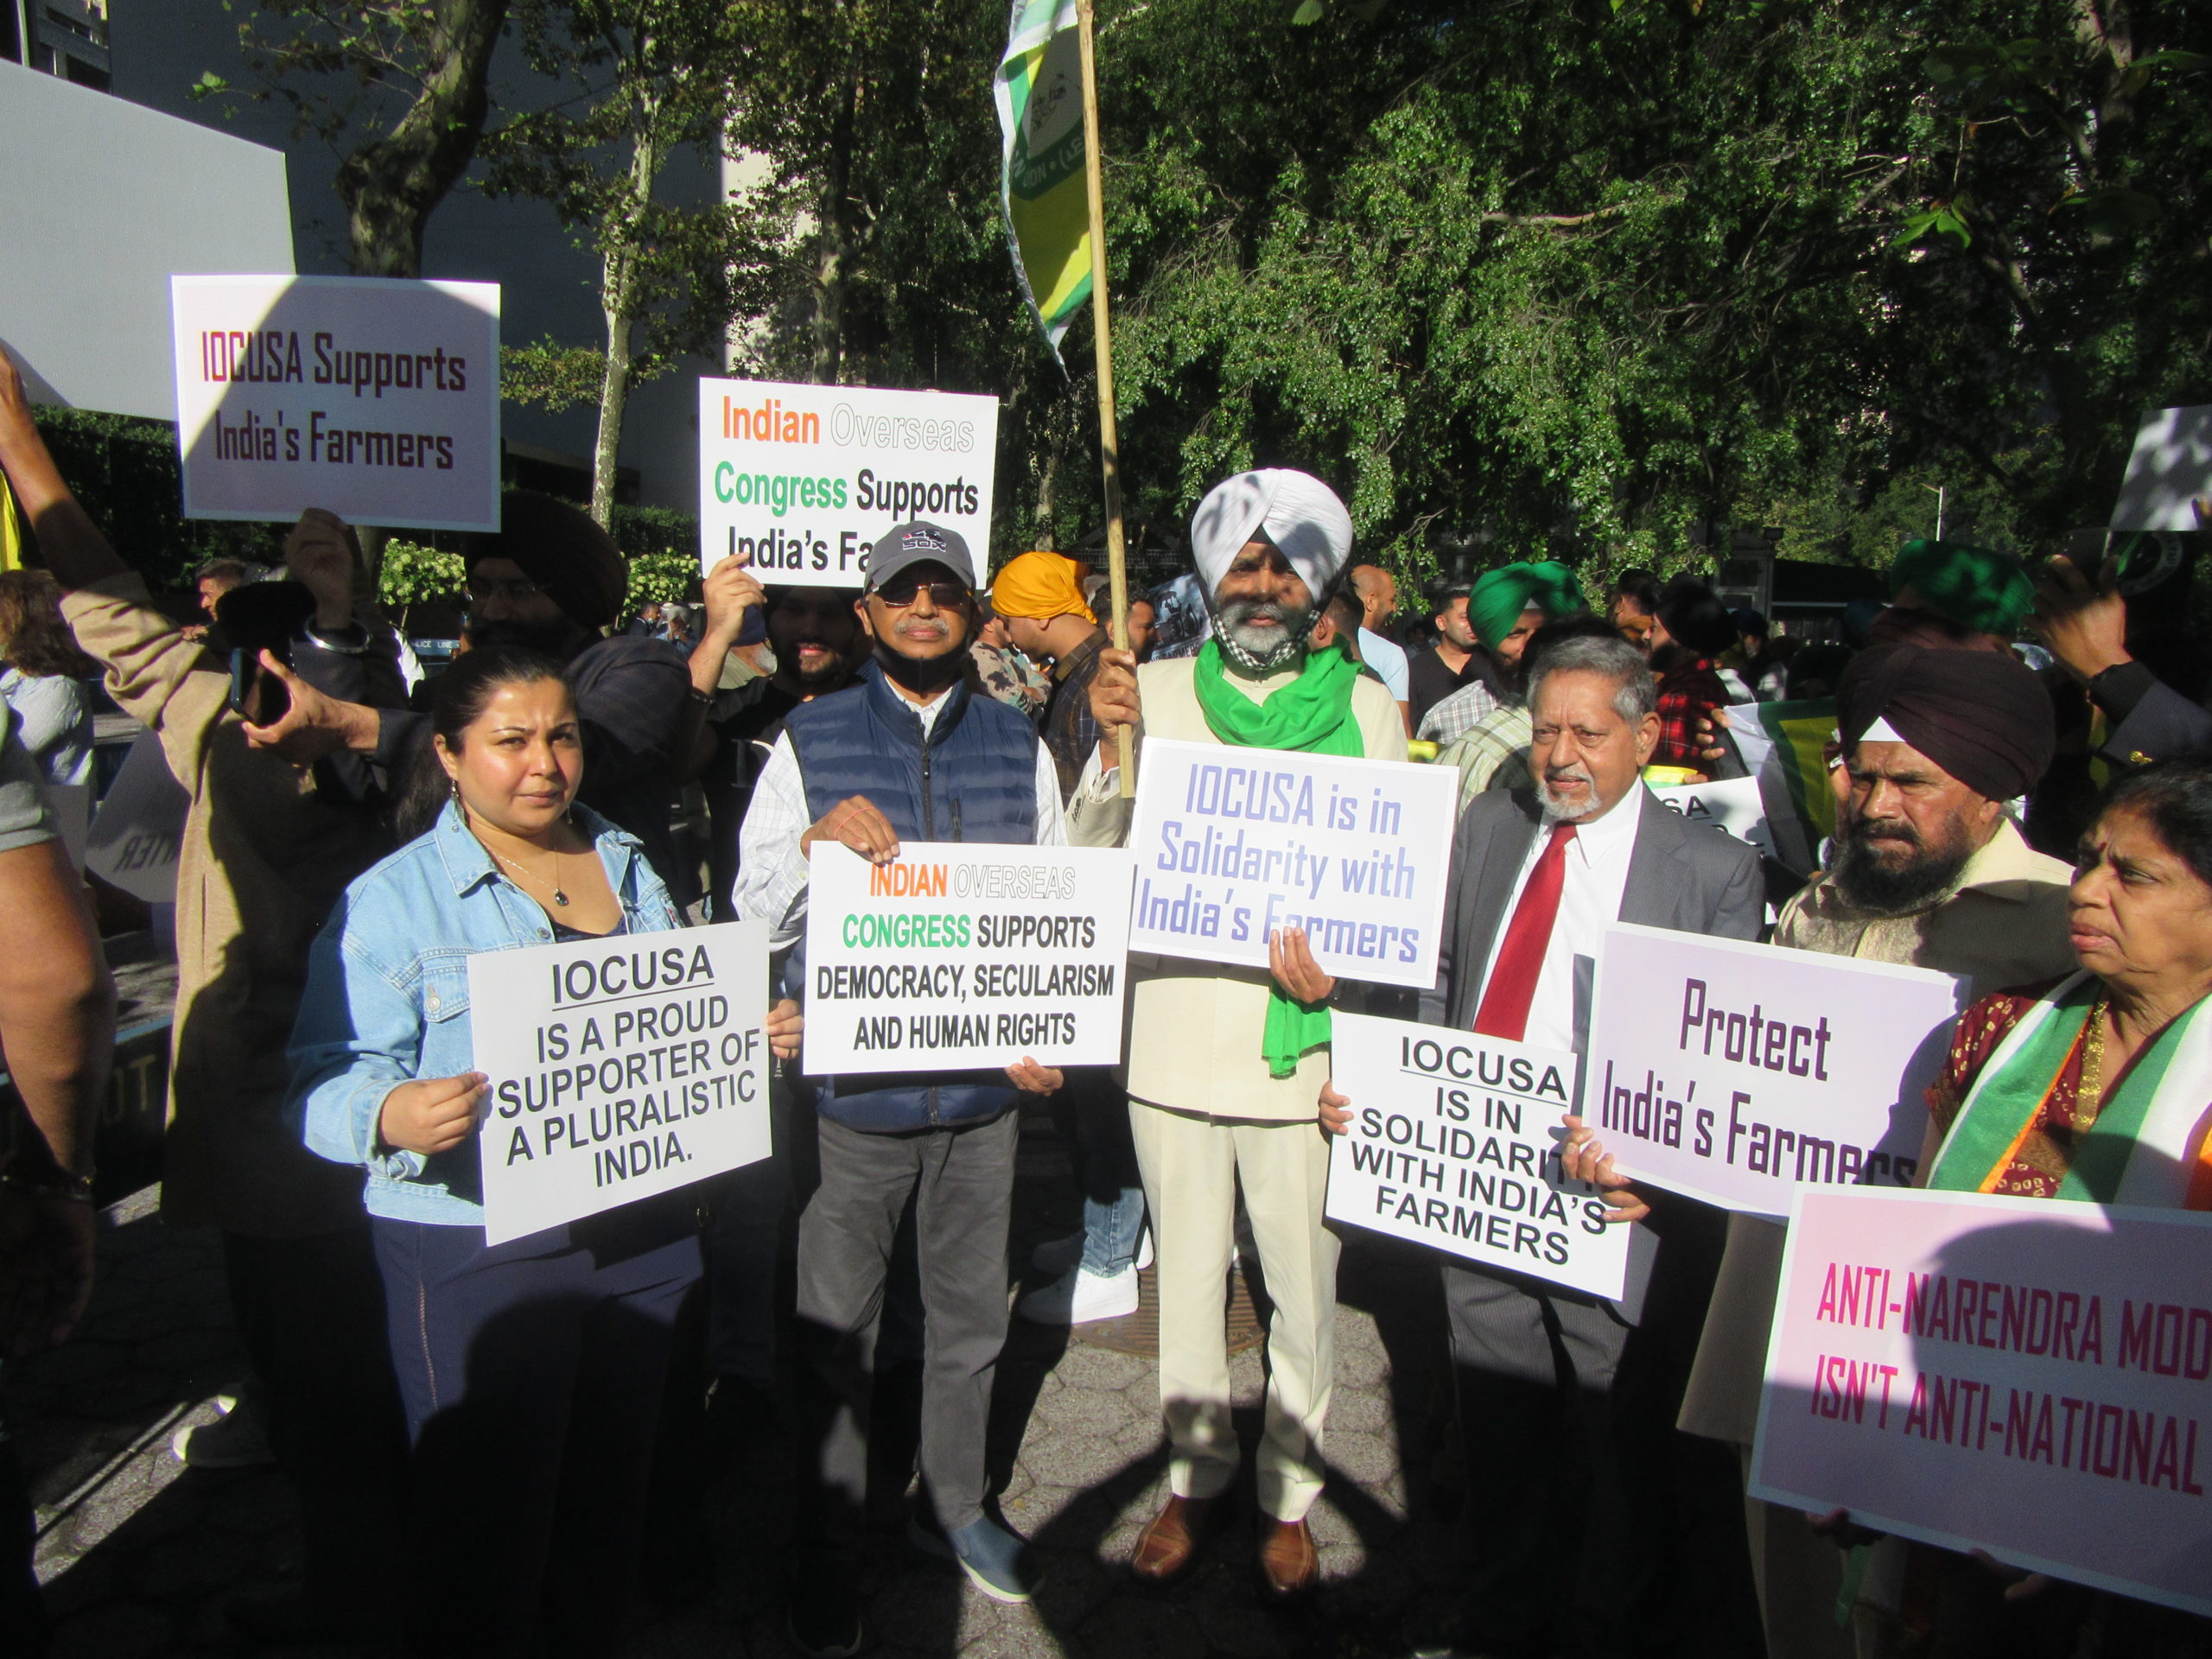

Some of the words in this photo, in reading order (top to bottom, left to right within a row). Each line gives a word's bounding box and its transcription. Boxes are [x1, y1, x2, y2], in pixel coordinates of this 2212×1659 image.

[202, 331, 303, 383] IOCUSA
[315, 332, 466, 397] Supports
[216, 410, 300, 461] India's
[311, 410, 453, 469] Farmers
[723, 396, 819, 444] Indian
[830, 403, 974, 452] Overseas
[715, 461, 848, 517] Congress
[856, 468, 978, 522] Supports
[729, 526, 829, 570] India's
[902, 538, 947, 552] SOX
[1185, 764, 1314, 826] IOCUSA
[1327, 784, 1357, 830] is
[1369, 788, 1402, 836] in
[870, 863, 948, 897] INDIAN
[954, 864, 1076, 899] OVERSEAS
[1157, 821, 1329, 899] Solidarity
[1341, 847, 1415, 899] with
[842, 914, 971, 948] CONGRESS
[977, 915, 1096, 948] SUPPORTS
[1138, 878, 1251, 942] India's
[553, 944, 715, 1003] IOCUSA
[817, 964, 968, 1003] DEMOCRACY,
[973, 964, 1115, 997] SECULARISM
[537, 1023, 569, 1064] IS
[580, 1017, 605, 1055] A
[614, 995, 728, 1047] PROUD
[854, 1016, 903, 1051] AND
[910, 1014, 989, 1049] HUMAN
[997, 1013, 1076, 1046] RIGHTS
[1680, 977, 1831, 1082] Protect
[498, 1039, 711, 1119] SUPPORTER
[721, 1028, 760, 1066] OF
[1402, 1036, 1567, 1102] IOCUSA
[506, 1126, 534, 1166] A
[543, 1070, 756, 1156] PLURALISTIC
[1436, 1086, 1470, 1122] IS
[1485, 1096, 1522, 1135] IN
[1602, 1059, 1714, 1158] India's
[1726, 1090, 1917, 1188] Farmers
[594, 1130, 693, 1187] INDIA.
[1360, 1108, 1592, 1192] SOLIDARIT
[1351, 1141, 1445, 1192] WITH
[1459, 1168, 1607, 1235] INDIA'S
[1376, 1185, 1569, 1265] FARMERS
[1816, 1262, 2102, 1365] ANTI-NARENDRA
[2118, 1300, 2212, 1380] MOD
[1811, 1354, 1898, 1430] ISN'T
[1904, 1371, 2203, 1496] ANTI-NATIONAL
